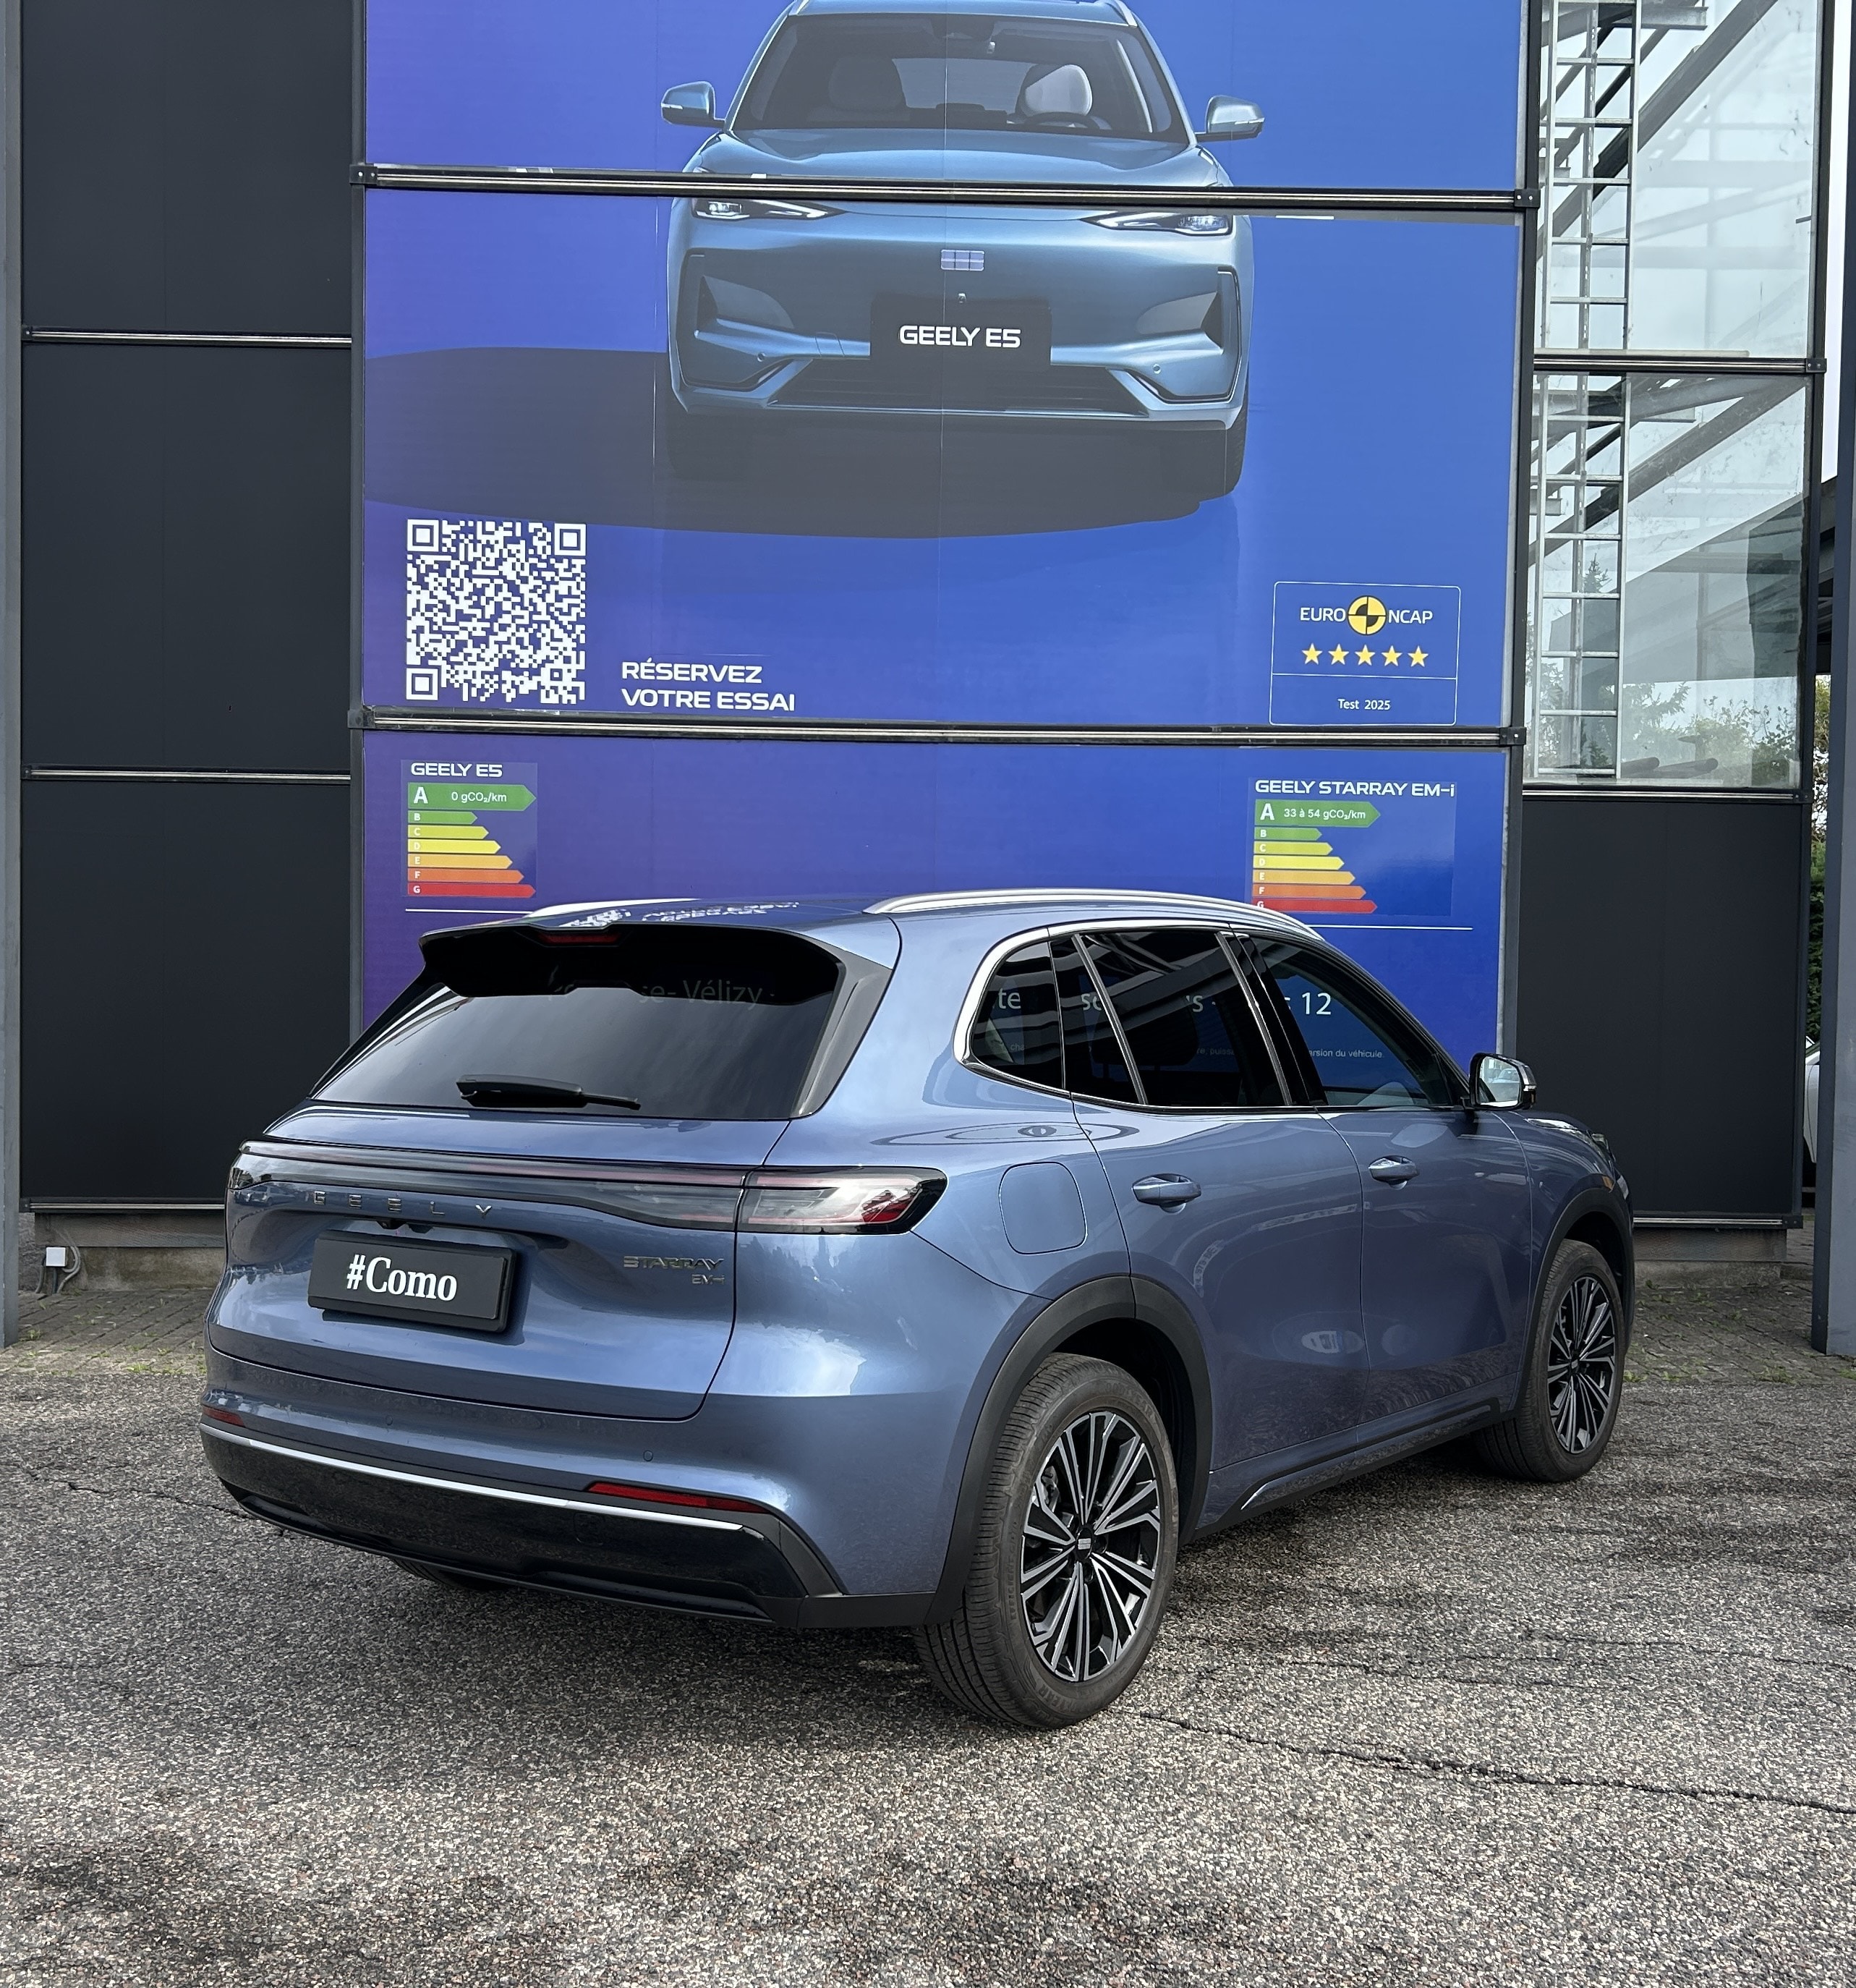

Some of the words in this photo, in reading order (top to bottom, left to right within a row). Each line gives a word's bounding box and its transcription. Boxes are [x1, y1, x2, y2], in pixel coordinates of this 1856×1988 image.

[899, 325, 981, 347] GEELY
[985, 327, 1021, 348] E5
[1300, 607, 1346, 622] EURO
[1388, 610, 1433, 624] NCAP
[621, 657, 762, 684] RÉSERVEZ
[621, 688, 711, 709] VOTRE
[717, 691, 795, 711] ESSAI
[1337, 698, 1360, 710] Test
[1364, 700, 1391, 710] 2025
[411, 763, 472, 776] GEELY
[476, 764, 503, 777] E5
[413, 786, 428, 804] A
[451, 792, 459, 801] 0
[1255, 780, 1316, 794] GEELY
[1319, 781, 1408, 796] STARRAY
[1412, 783, 1455, 797] EM-i
[1260, 803, 1274, 820] A
[1284, 809, 1297, 817] 33
[1299, 808, 1306, 817] à
[1308, 809, 1320, 818] 54
[414, 828, 421, 836] C
[1302, 993, 1332, 1015] 12
[1335, 1049, 1346, 1058] du
[313, 1190, 492, 1218] GEELY
[346, 1254, 457, 1301] #Como
